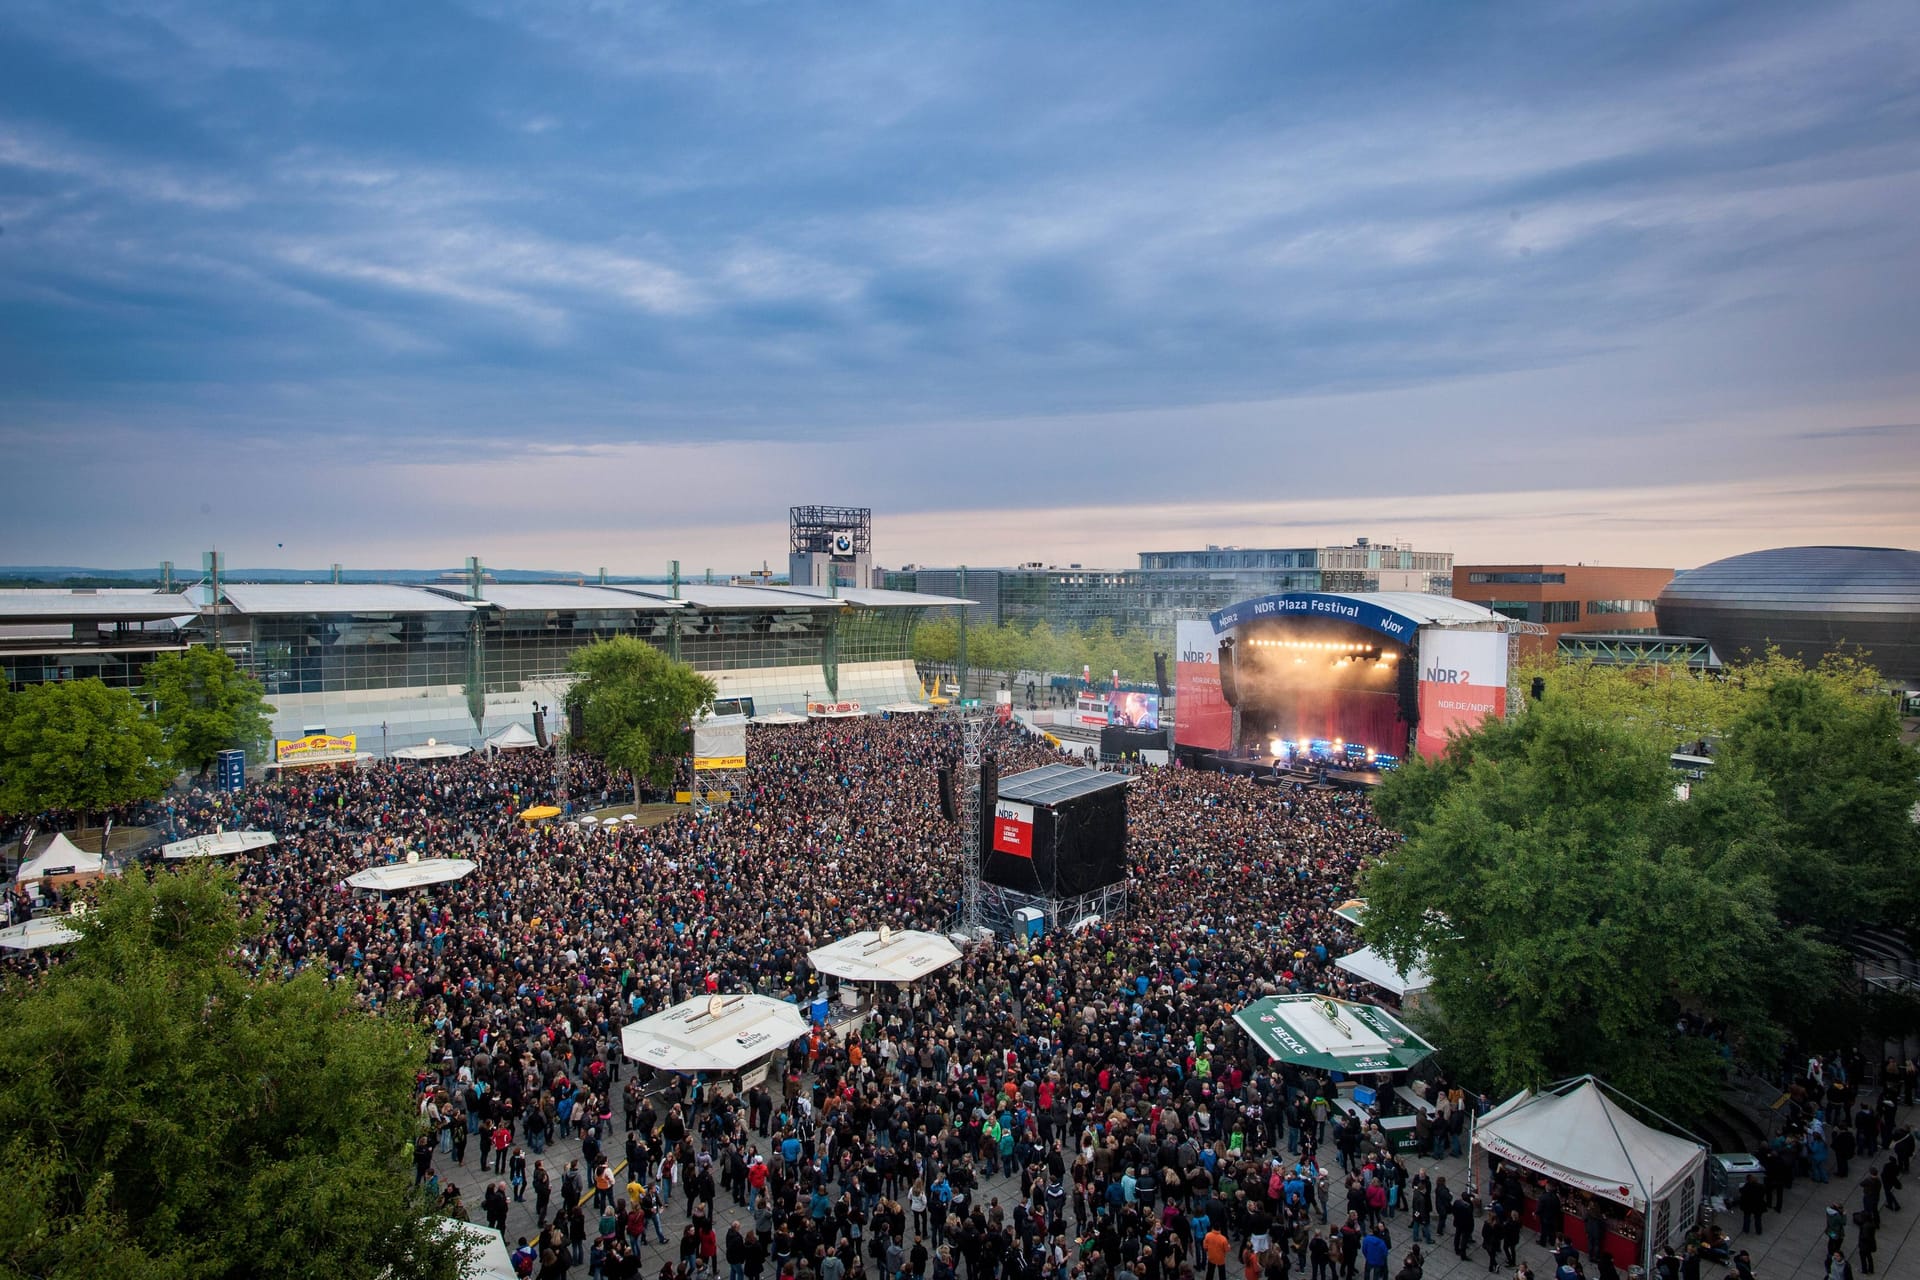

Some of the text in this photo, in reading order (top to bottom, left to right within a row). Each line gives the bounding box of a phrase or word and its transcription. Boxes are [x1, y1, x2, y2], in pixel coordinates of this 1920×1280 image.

[1254, 600, 1359, 617] NDR Plaza Festival
[1220, 613, 1238, 627] NDR 2
[1183, 646, 1212, 664] NDR 2
[1426, 663, 1470, 685] NDR 2
[1438, 700, 1495, 713] NDR.DE/NDR2
[280, 741, 307, 753] BAMBUS
[329, 739, 352, 747] GOURMET
[999, 805, 1019, 821] NDR 2
[1271, 1026, 1308, 1055] BECK'S
